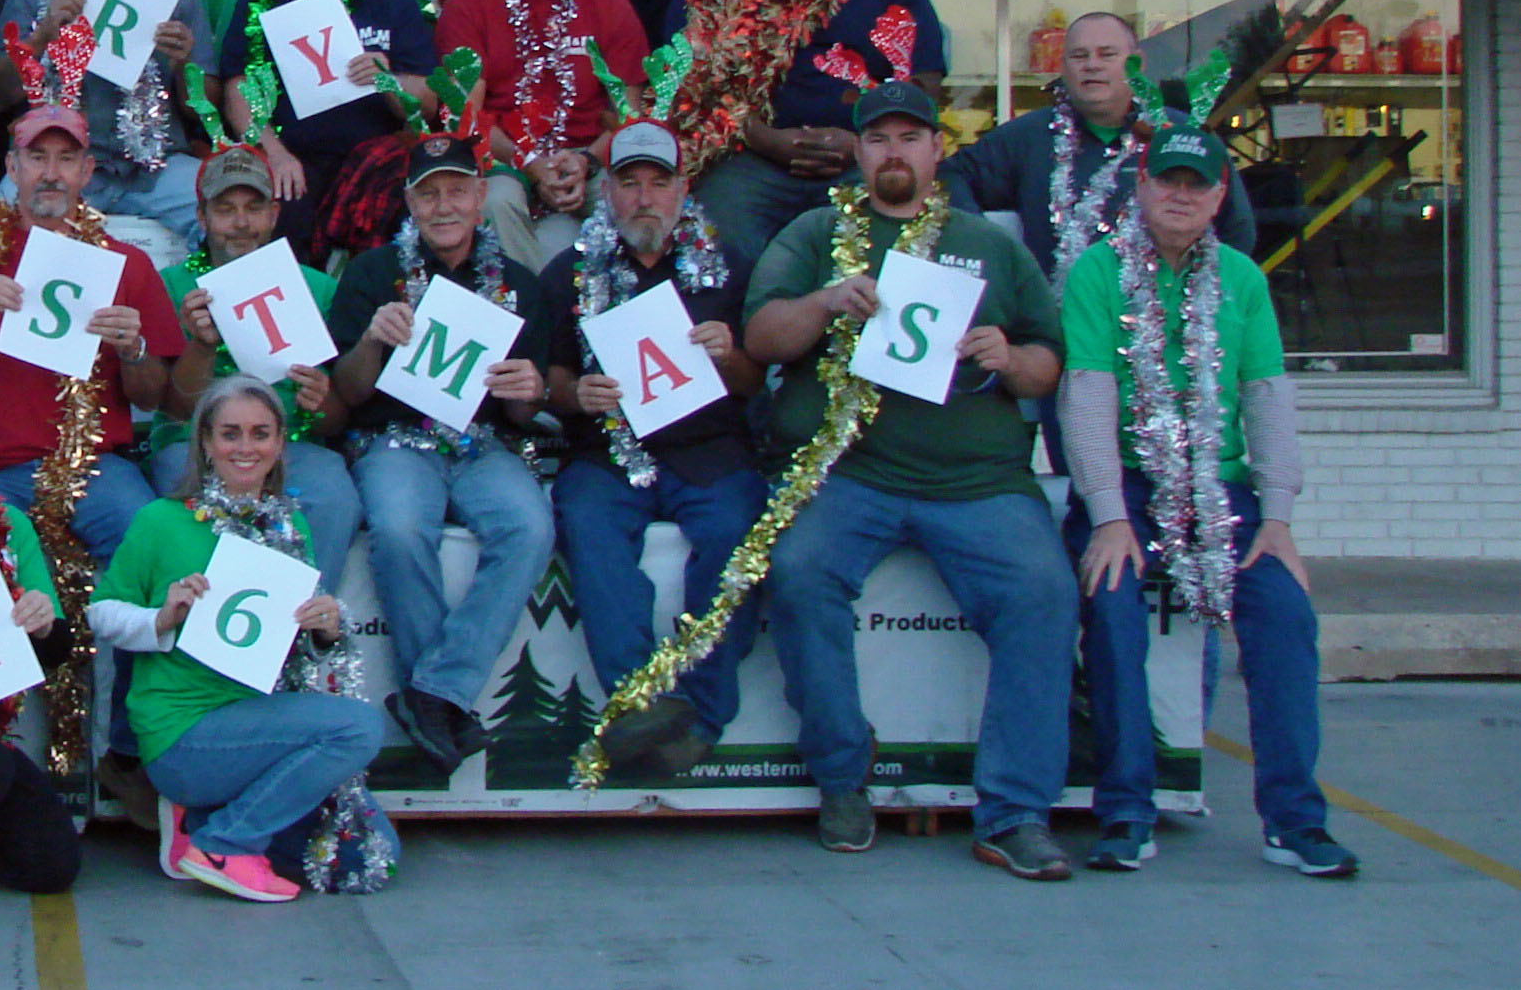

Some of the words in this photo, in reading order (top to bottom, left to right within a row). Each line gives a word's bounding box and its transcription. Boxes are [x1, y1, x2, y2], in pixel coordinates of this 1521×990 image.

[290, 27, 337, 86] Y
[939, 253, 982, 270] M&M
[29, 279, 84, 339] S
[233, 286, 291, 355] T
[402, 317, 489, 400] M
[638, 336, 692, 405] A
[887, 301, 939, 364] S
[215, 588, 269, 648] 6
[870, 612, 968, 632] Product
